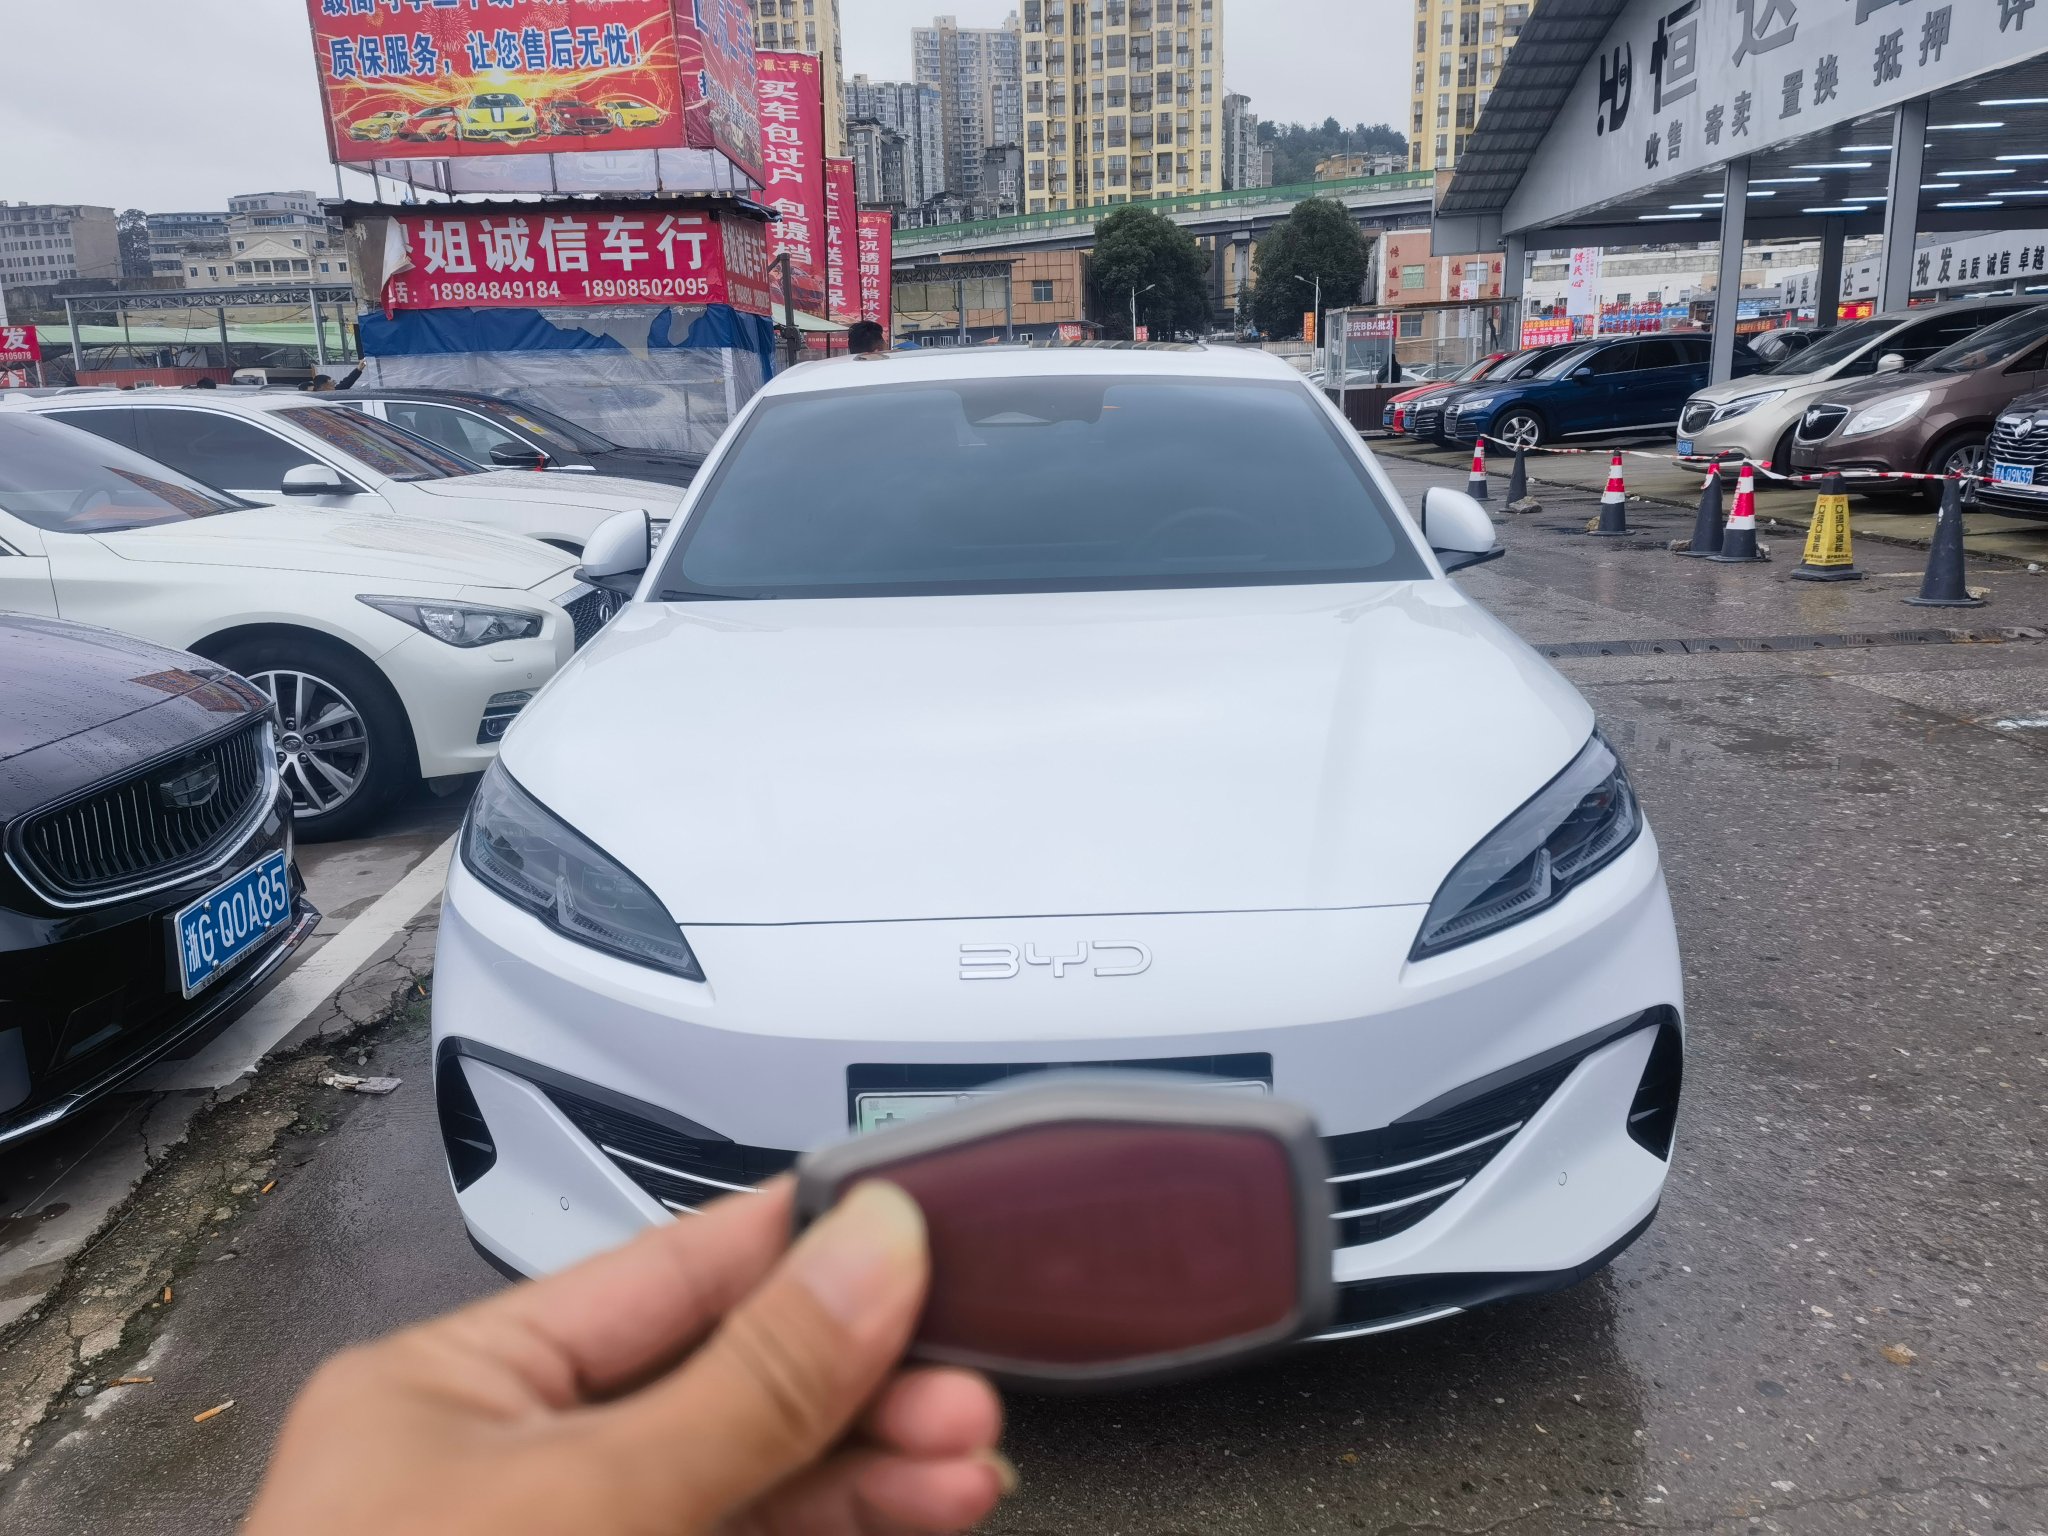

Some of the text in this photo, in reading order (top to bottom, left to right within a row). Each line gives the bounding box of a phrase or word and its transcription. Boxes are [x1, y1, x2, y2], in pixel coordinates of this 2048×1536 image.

[1704, 90, 1752, 145] 寄卖
[1779, 54, 1838, 120] 置换
[1873, 4, 1952, 87] 抵押
[1915, 245, 2046, 287] 批发 品质 诚信 卓越
[430, 280, 560, 301] 18984849184
[582, 277, 709, 298] 18908502095
[2, 327, 30, 350] 发
[958, 939, 1153, 981] BYD
